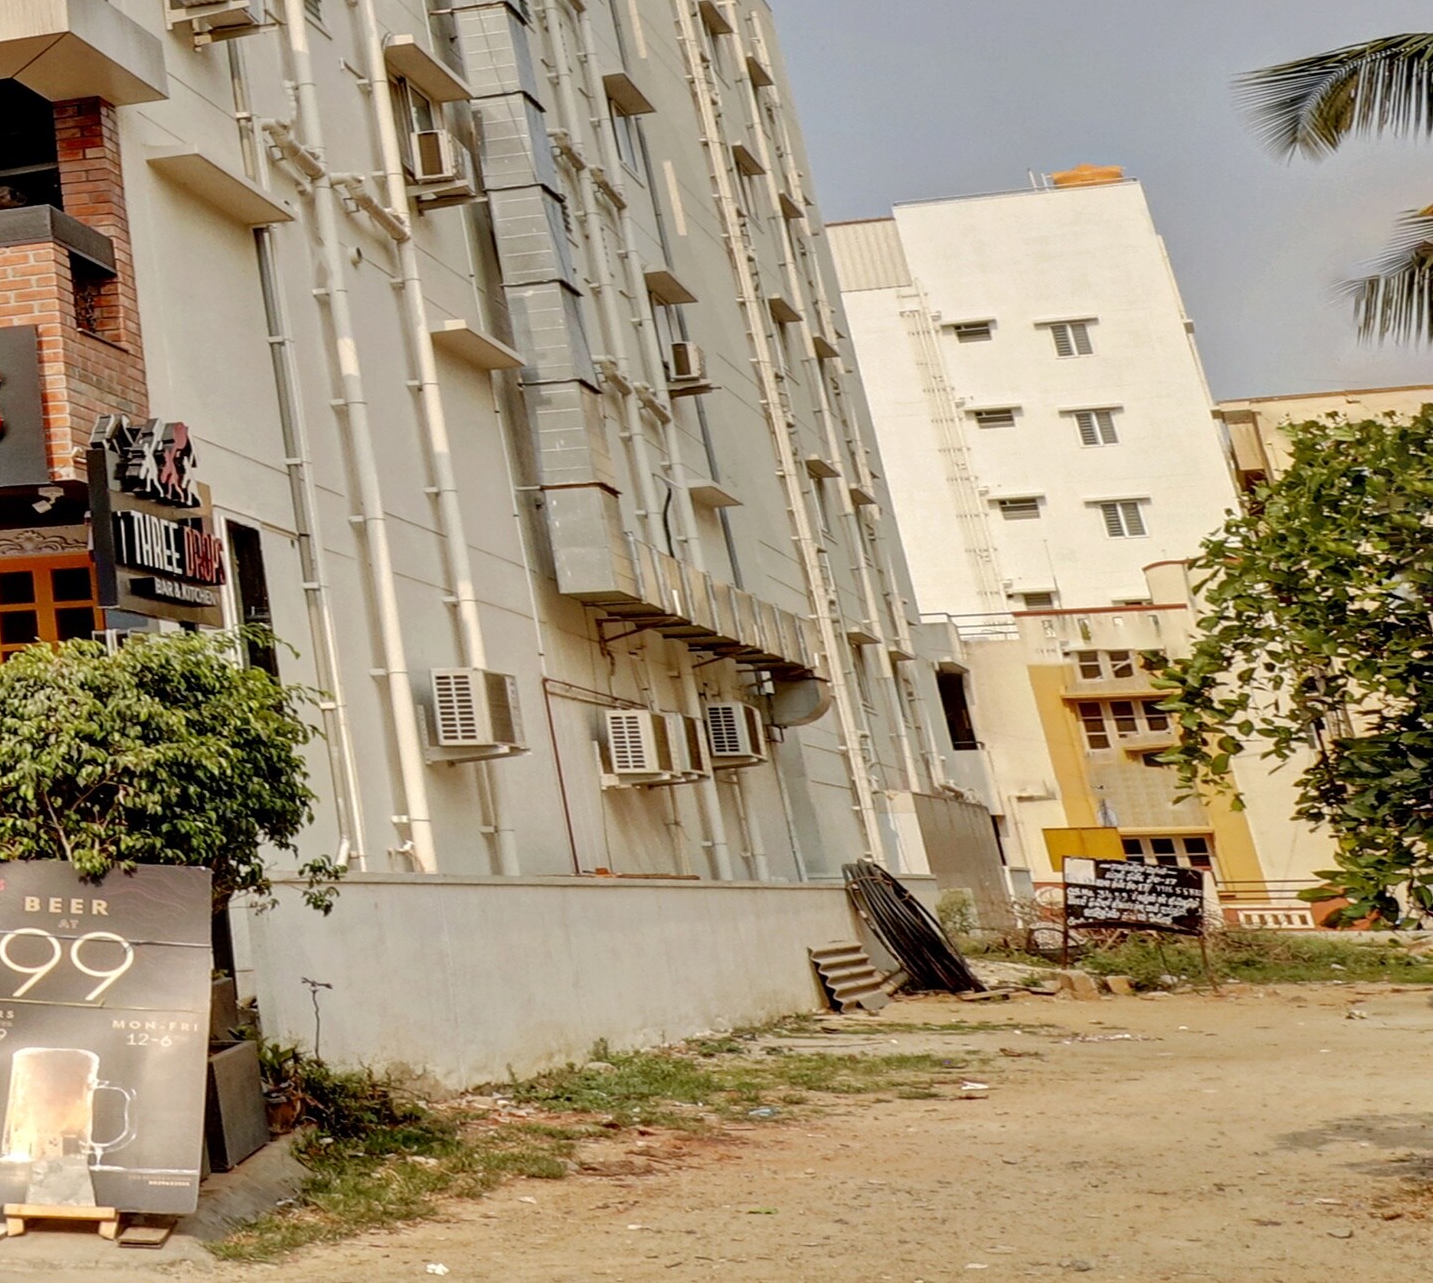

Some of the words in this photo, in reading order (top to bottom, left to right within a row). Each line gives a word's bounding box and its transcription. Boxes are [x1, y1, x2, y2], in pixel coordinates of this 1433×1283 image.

[131, 510, 183, 575] THREE
[183, 526, 226, 584] DROPS
[24, 896, 109, 916] BEER
[58, 919, 79, 929] AT
[112, 1020, 198, 1032] MON-FRI
[126, 1033, 173, 1047] 12-6
